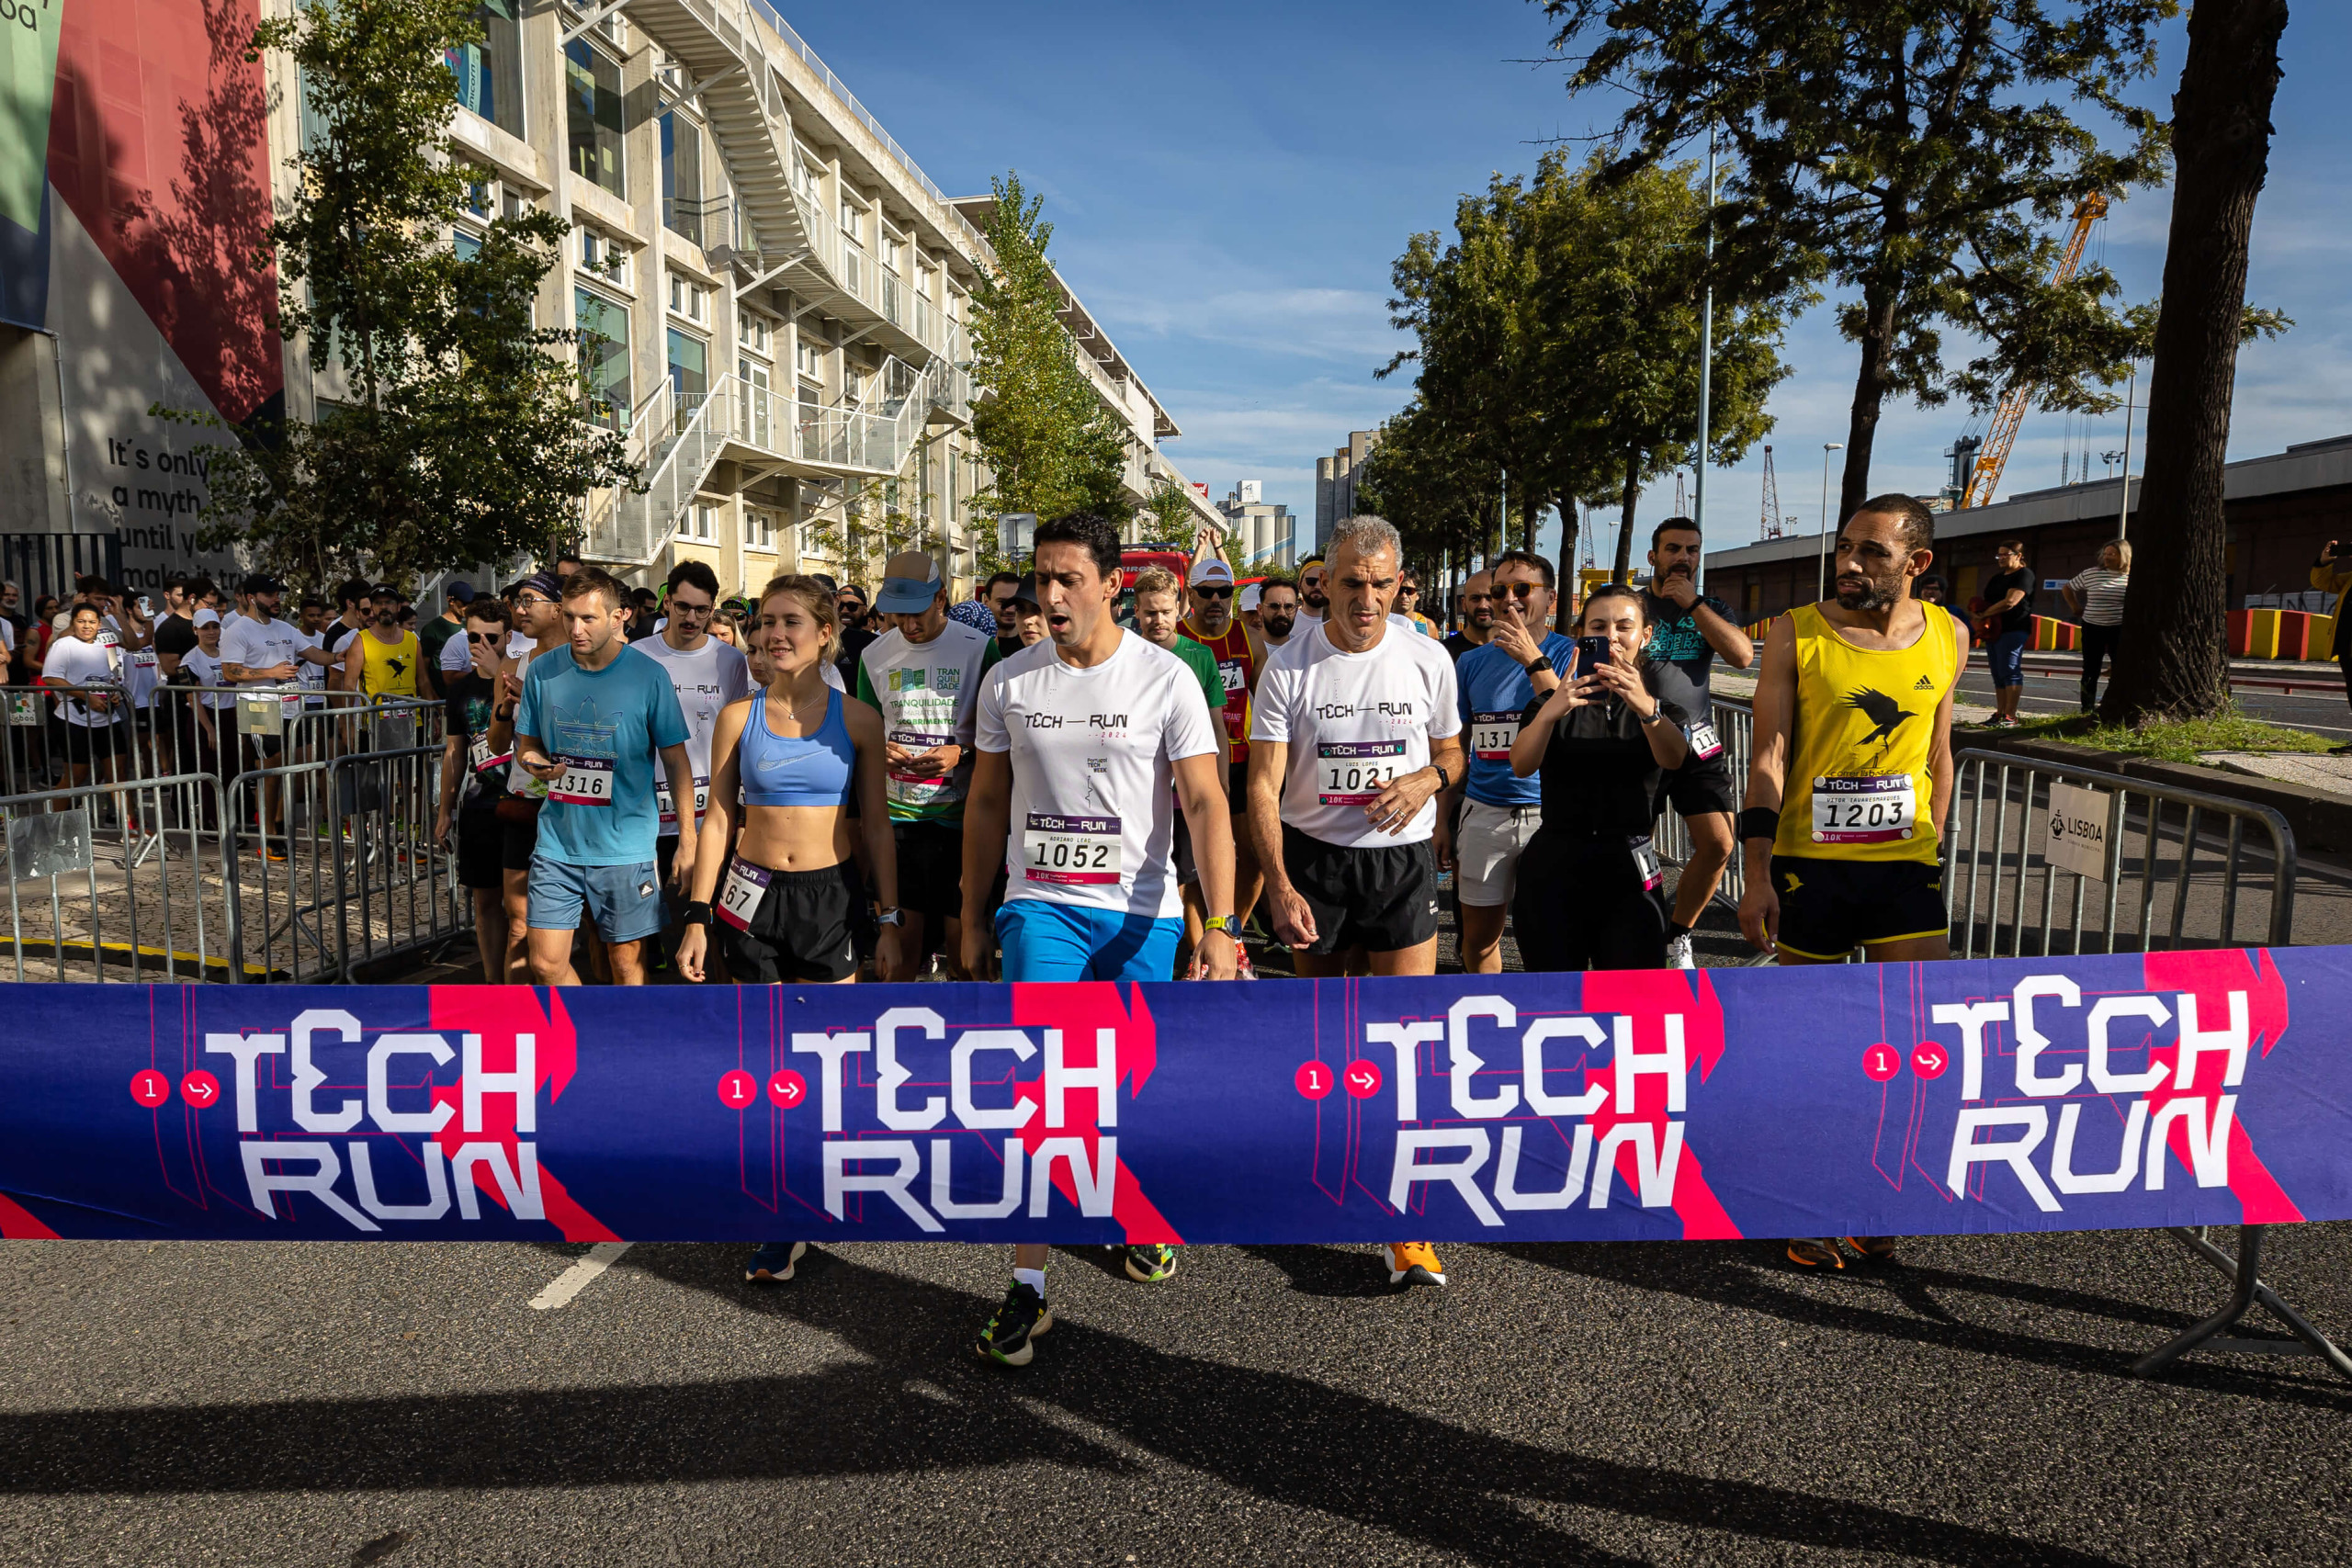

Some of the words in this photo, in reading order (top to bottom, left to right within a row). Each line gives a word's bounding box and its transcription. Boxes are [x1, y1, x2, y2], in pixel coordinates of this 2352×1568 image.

[157, 451, 209, 484] only
[112, 485, 129, 507] a
[137, 488, 201, 518] myth
[116, 525, 175, 550] until
[1677, 616, 1696, 628] 43
[697, 684, 719, 694] RUN
[937, 675, 959, 683] QUILI
[889, 698, 959, 709] TRANQUILIDADE
[1316, 703, 1354, 719] TECH
[1378, 702, 1412, 716] RUN
[1024, 712, 1063, 728] TECH
[1090, 714, 1128, 729] RUN
[926, 737, 945, 745] RUN
[1331, 745, 1356, 755] TECH
[1372, 744, 1395, 755] RUN
[584, 761, 603, 769] RUN
[555, 774, 603, 795] 1316
[1329, 766, 1394, 790] 1021
[1829, 779, 1859, 790] TECH
[1876, 779, 1901, 790] RUN
[1329, 795, 1343, 804] 10K
[1040, 817, 1065, 829] TECH
[1081, 820, 1106, 831] RUN
[1824, 802, 1903, 827] 1203
[1825, 833, 1841, 841] 10K
[2068, 817, 2103, 842] LISBOA
[1034, 842, 1109, 868] 1052
[739, 864, 759, 881] RUN
[1035, 872, 1050, 880] 10K
[1932, 975, 2249, 1100] TECH
[1366, 995, 1687, 1121] TECH
[1875, 1053, 1888, 1072] 1
[205, 1009, 536, 1132] TECH
[792, 1007, 1117, 1132] TECH
[144, 1079, 156, 1099] 1
[731, 1079, 744, 1099] 1
[1308, 1071, 1320, 1089] 1
[1947, 1094, 2238, 1212] RUN
[1388, 1121, 1686, 1226] RUN
[240, 1142, 546, 1231] RUN
[822, 1136, 1117, 1232] RUN
